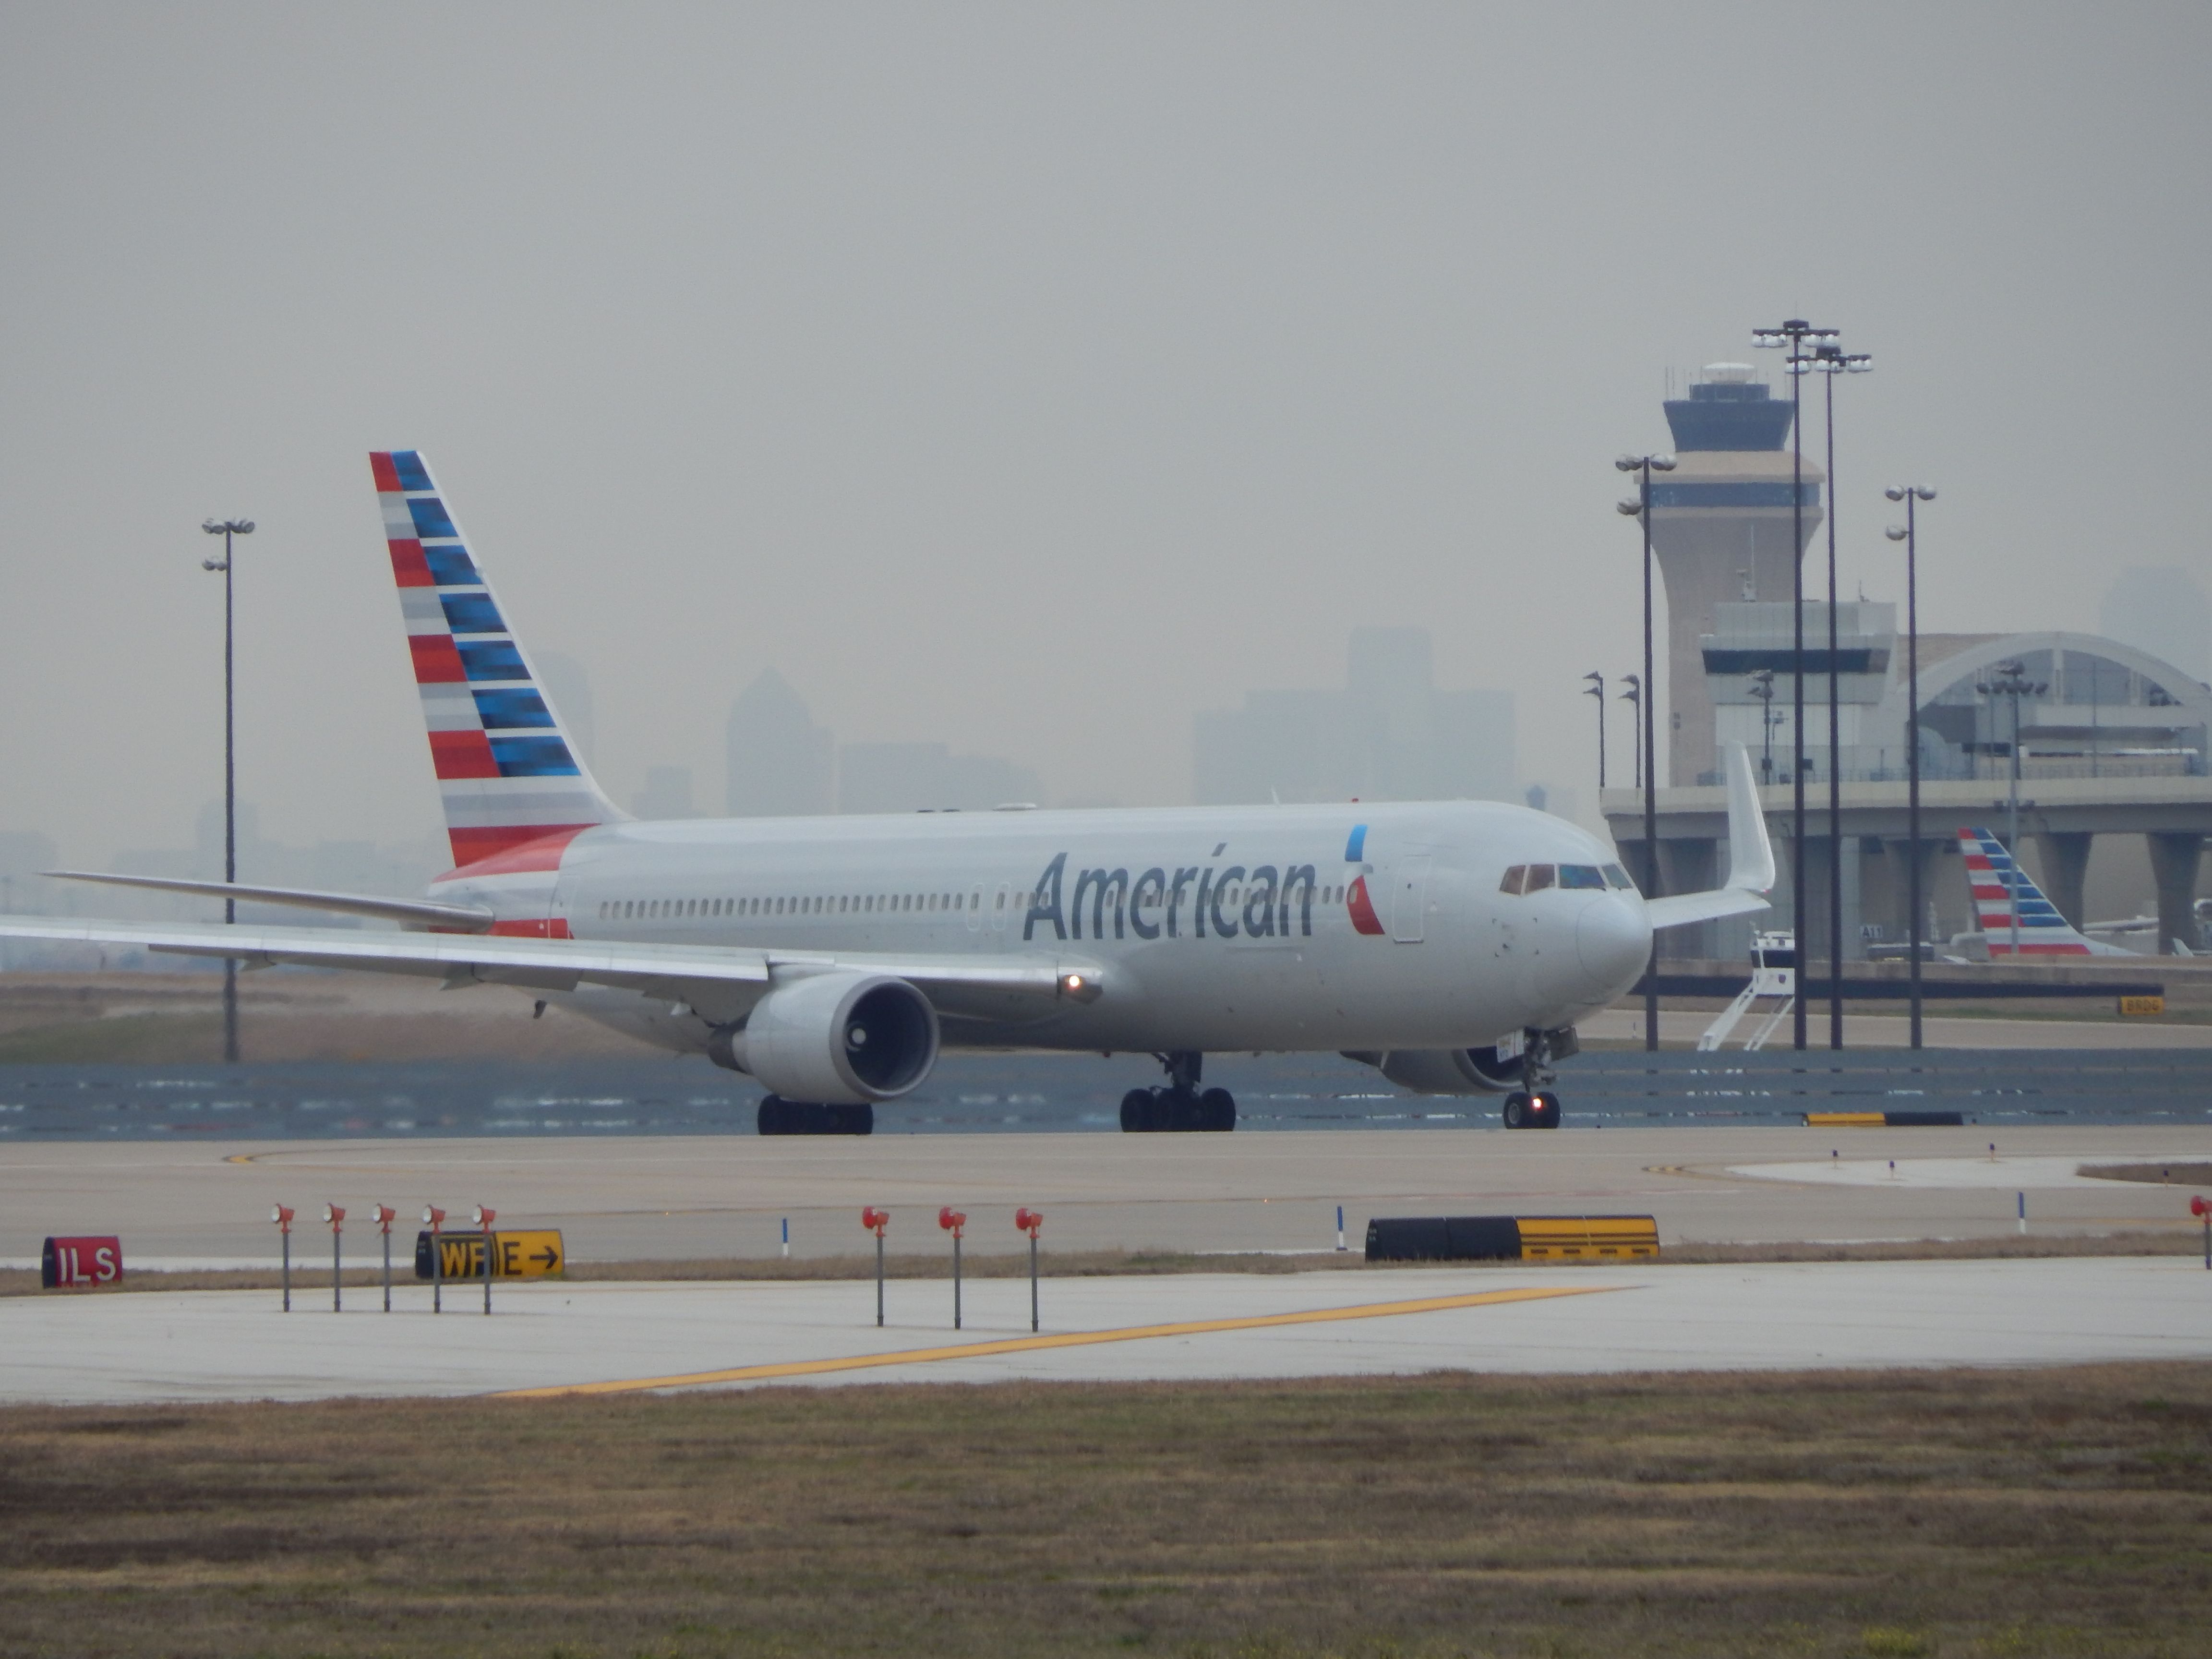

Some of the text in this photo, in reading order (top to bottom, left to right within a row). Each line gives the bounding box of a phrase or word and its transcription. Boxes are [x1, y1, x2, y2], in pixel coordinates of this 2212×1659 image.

[1023, 842, 1315, 940] American
[1862, 926, 1881, 938] A11
[59, 1247, 116, 1282] ILS
[504, 1241, 522, 1275] E
